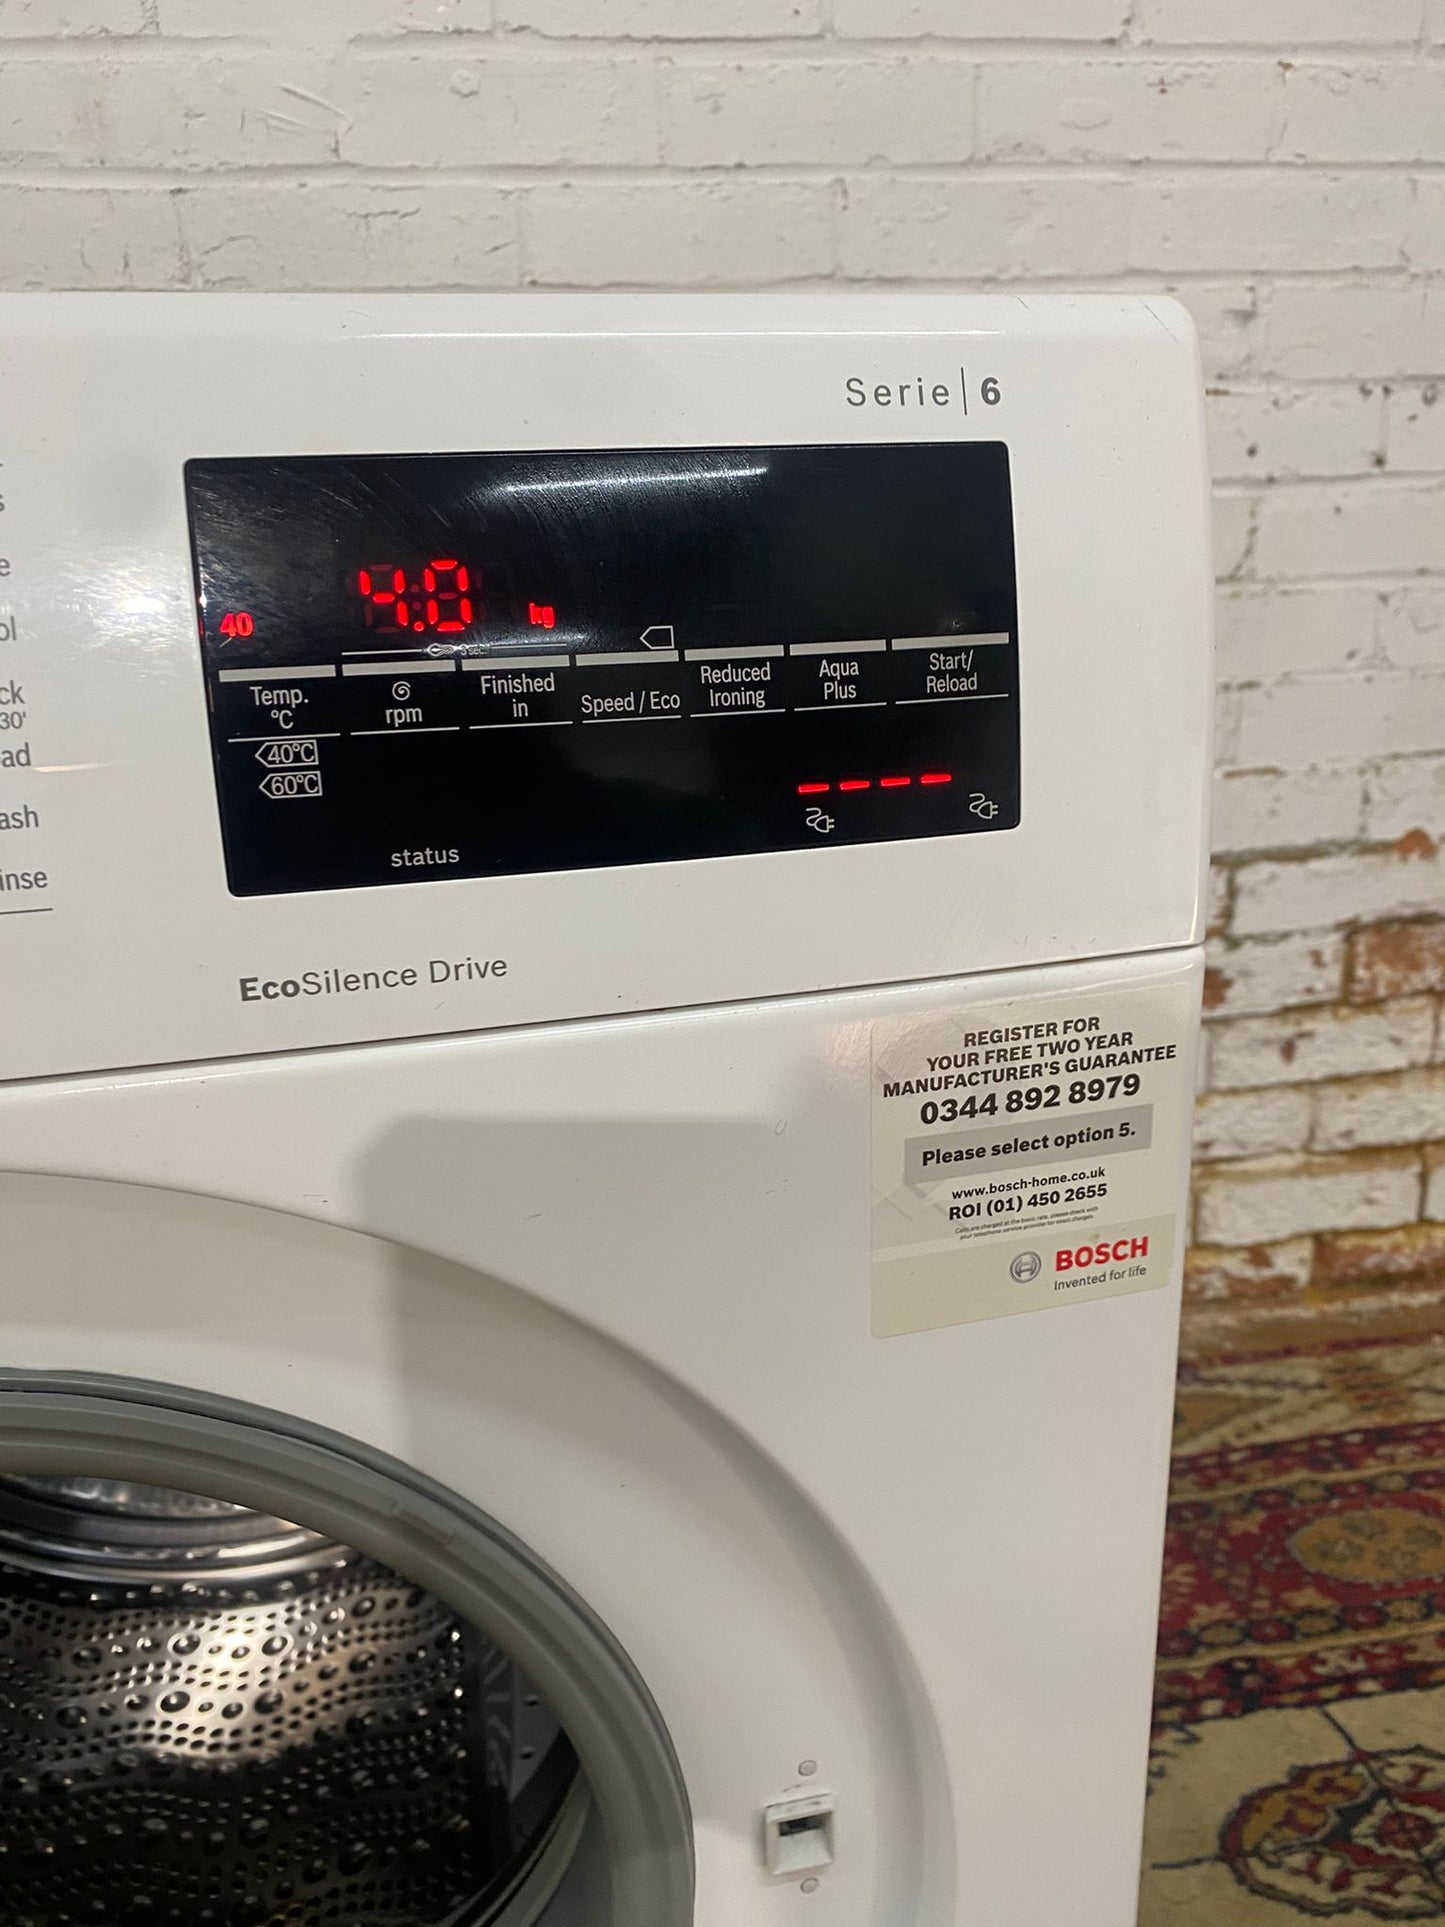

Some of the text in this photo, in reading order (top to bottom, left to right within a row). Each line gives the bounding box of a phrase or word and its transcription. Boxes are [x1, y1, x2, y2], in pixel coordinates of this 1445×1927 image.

[845, 376, 1001, 407] Serie 6
[219, 611, 254, 638] 40
[818, 659, 860, 681] Aqua
[929, 649, 975, 672] Start/
[480, 672, 556, 695] Finished
[700, 661, 772, 685] Reduced
[926, 672, 978, 694] Reload
[249, 686, 310, 709] Temp.
[709, 686, 766, 709] Ironing
[823, 680, 858, 700] Plus
[270, 709, 295, 730] °C
[385, 705, 424, 728] rpm
[512, 698, 530, 719] in
[267, 742, 316, 764] 40°C
[271, 773, 320, 796] 60°C
[390, 848, 460, 867] status
[239, 956, 508, 1001] EcoSilence Drive
[963, 1016, 1101, 1047] REGISTER FOR
[926, 1031, 1134, 1072] YOUR FREE TWO YEAR
[883, 1044, 1177, 1098] MANUFACTURER'S GUARANTEE
[919, 1072, 1141, 1125] 0344 892 8979
[922, 1121, 1136, 1167] Please select option 5.
[951, 1166, 1106, 1200] www.bosch-home.co.uk
[948, 1182, 1108, 1221] ROI (01) 450 2655
[1055, 1235, 1149, 1272] BOSCH
[1054, 1264, 1147, 1291] Invented for life
